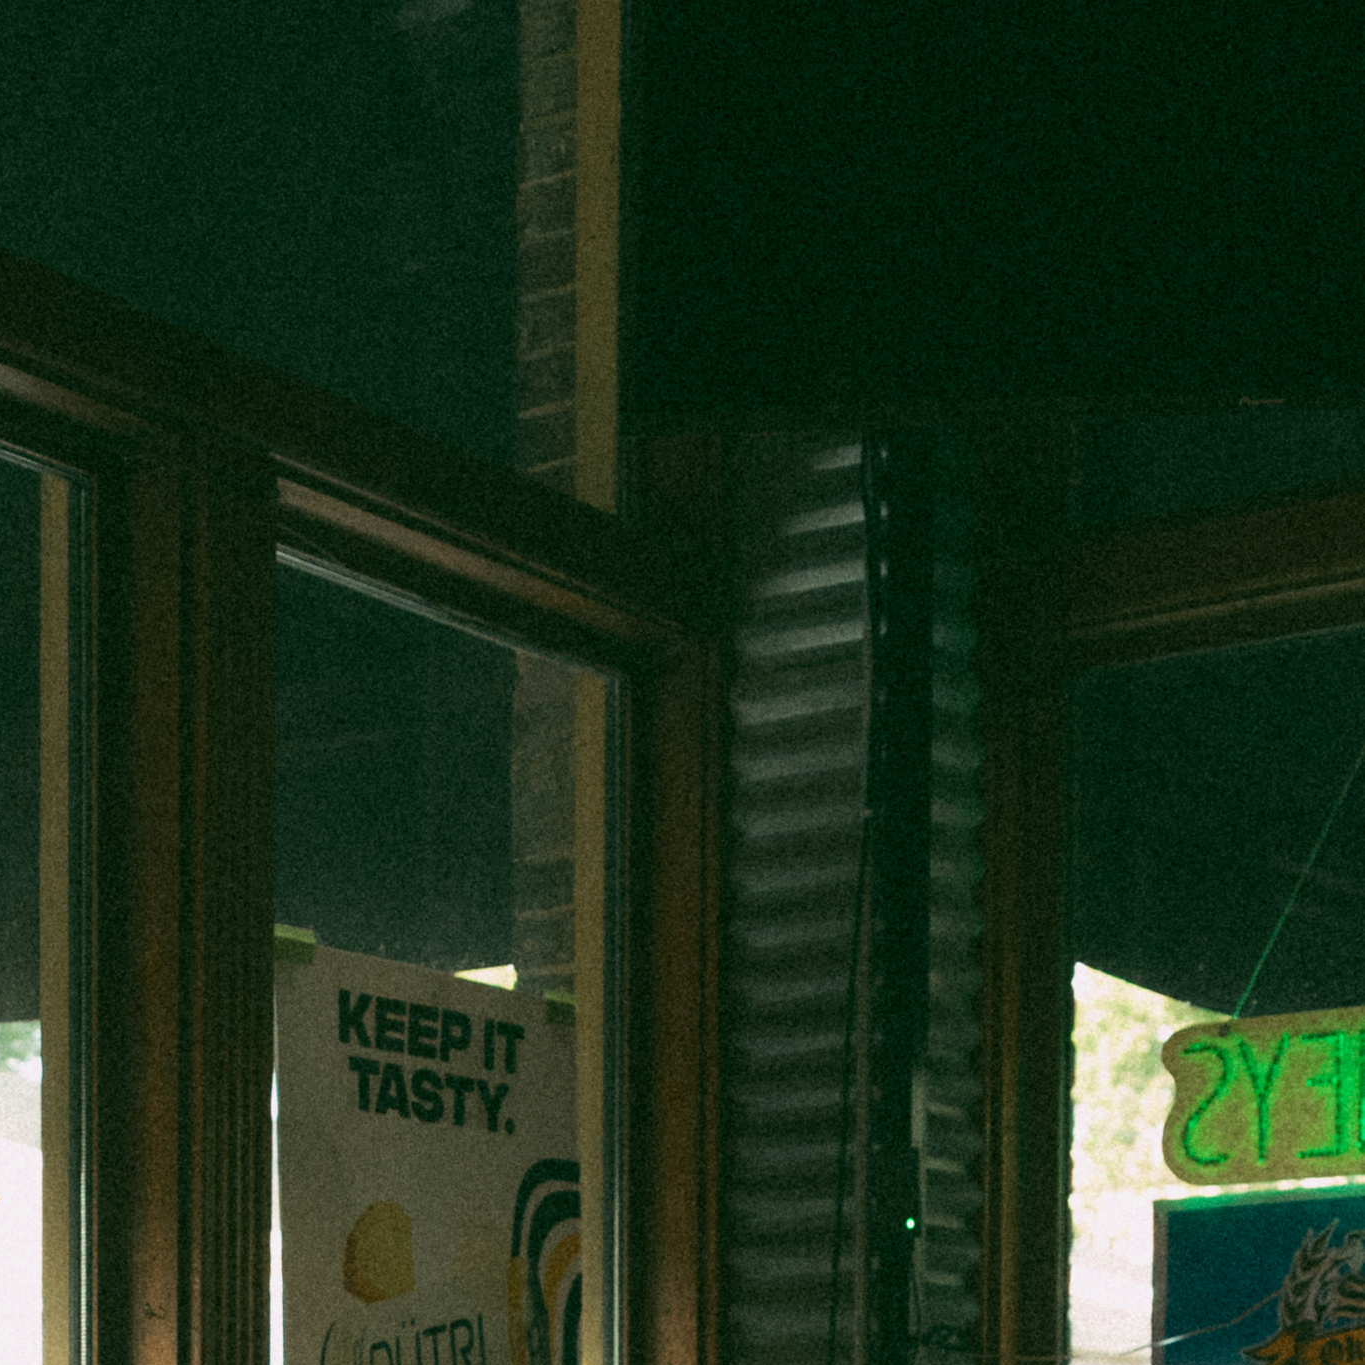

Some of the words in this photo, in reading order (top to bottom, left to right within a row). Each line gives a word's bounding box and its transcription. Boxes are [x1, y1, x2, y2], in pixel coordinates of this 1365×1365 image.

[338, 989, 472, 1063] KEEP
[483, 1019, 525, 1075] IT
[348, 1056, 515, 1135] TASTY.
